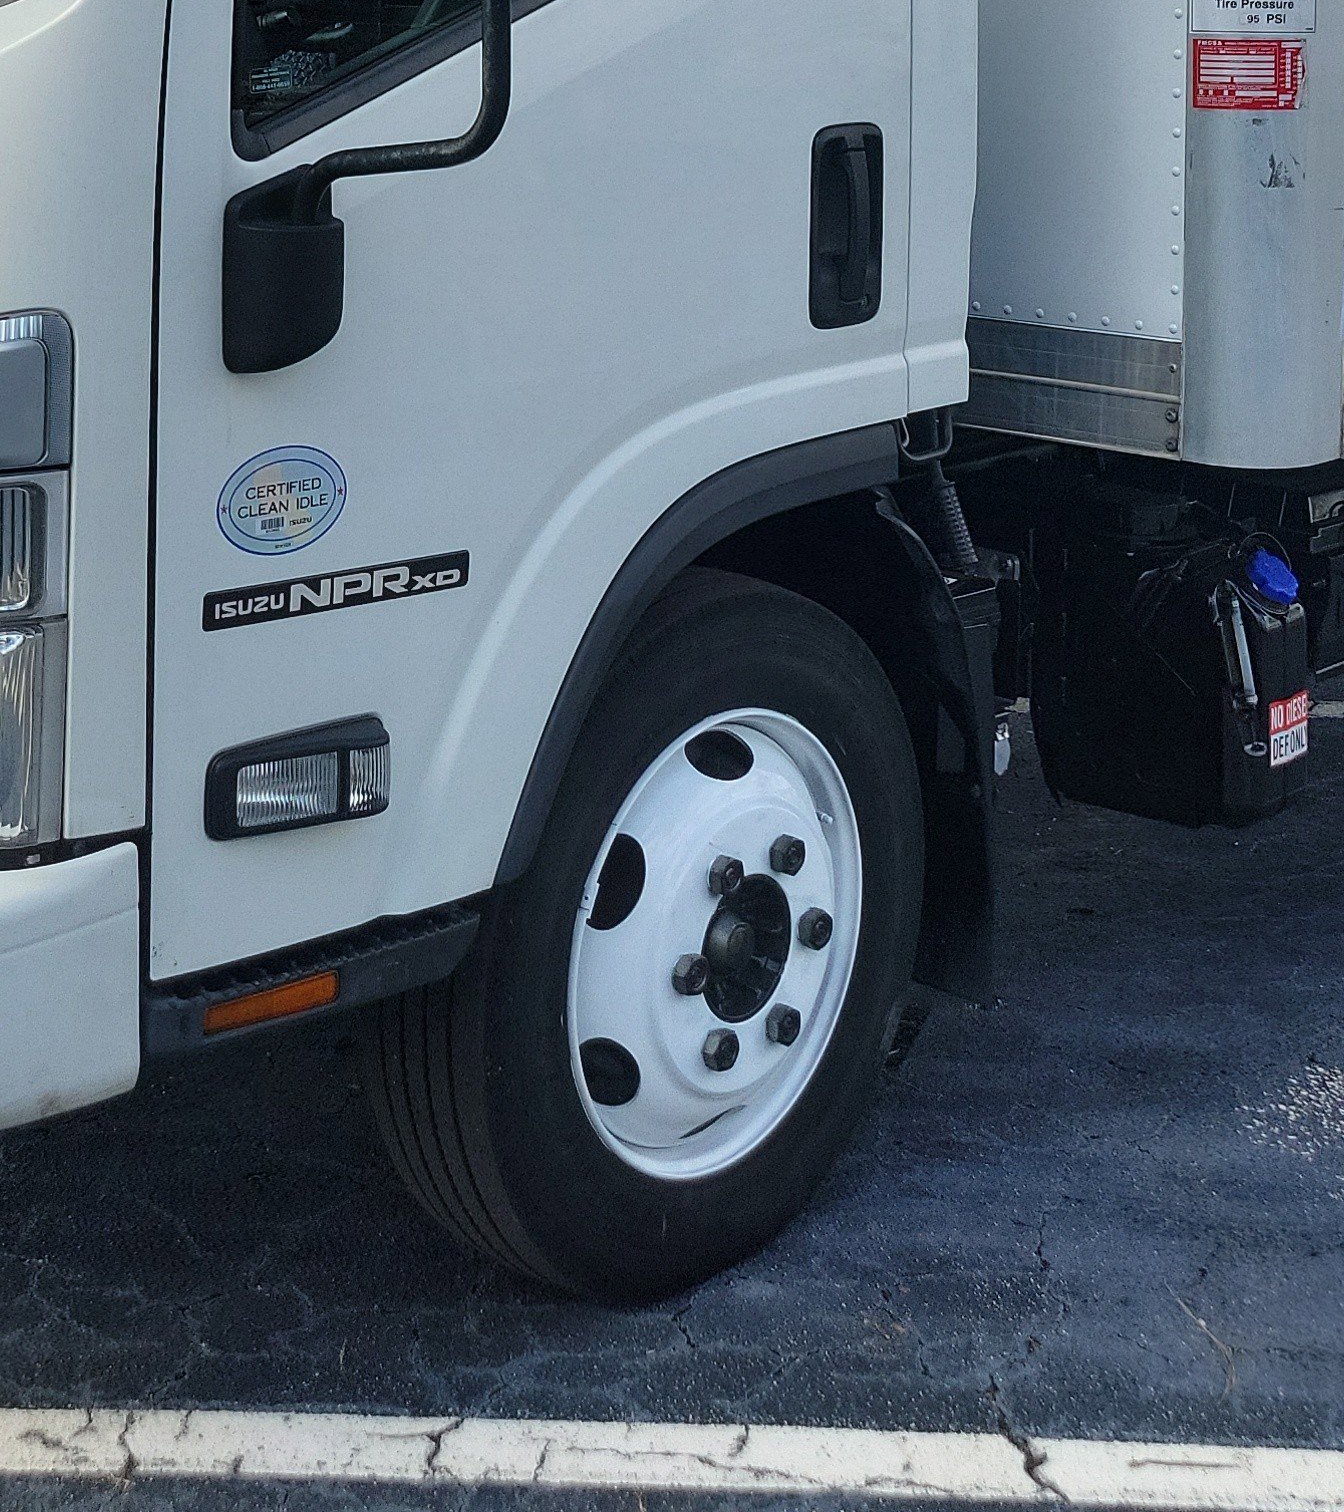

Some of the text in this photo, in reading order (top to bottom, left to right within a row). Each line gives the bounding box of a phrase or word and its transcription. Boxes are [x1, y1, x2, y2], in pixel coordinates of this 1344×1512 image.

[1246, 14, 1286, 24] 95 PSI
[245, 476, 322, 500] CERTIFIED
[237, 493, 329, 519] CLEAN IDLE
[289, 517, 313, 526] ISUZU
[214, 592, 285, 619] ISUZU
[1270, 704, 1285, 731] NO
[1272, 733, 1289, 761] DEF
